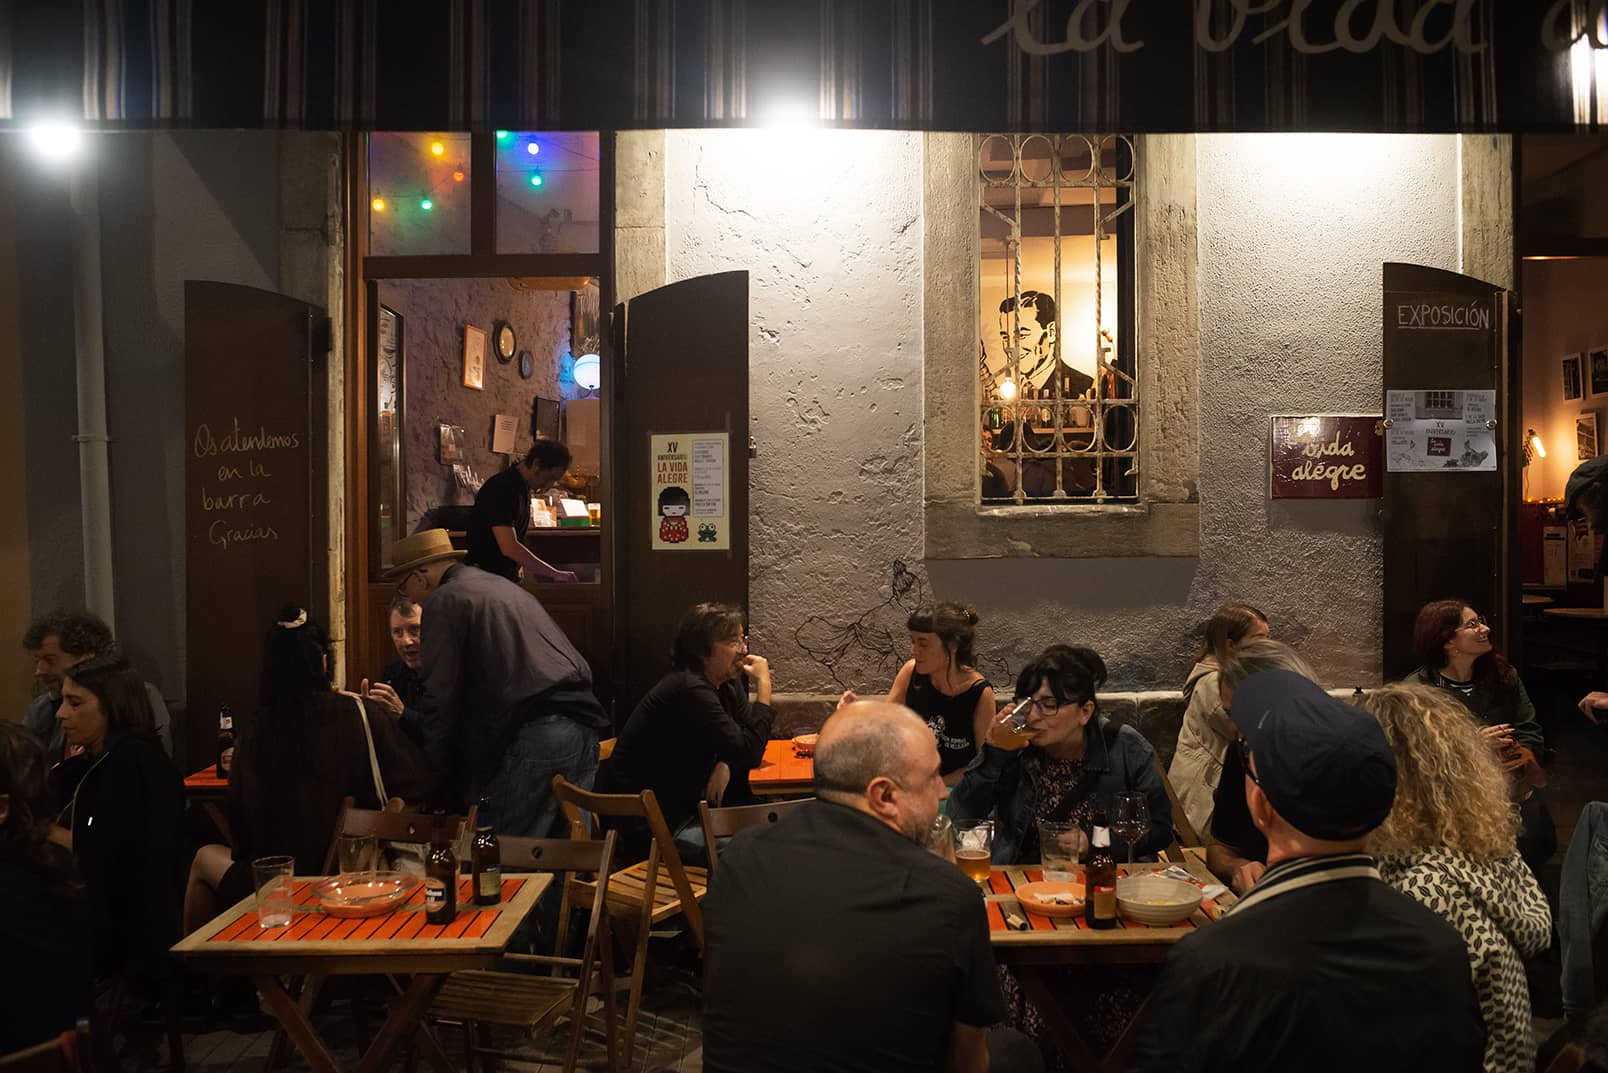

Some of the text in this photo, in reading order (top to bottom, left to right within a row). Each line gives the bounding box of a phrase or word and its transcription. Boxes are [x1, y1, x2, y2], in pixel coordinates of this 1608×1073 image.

[1397, 300, 1490, 329] EXPOSICIÓN
[194, 416, 300, 457] Os atendemos
[667, 441, 678, 453] XV
[218, 458, 272, 480] en la
[657, 462, 688, 472] LA VIDA
[657, 473, 688, 484] ALEGRE
[202, 488, 271, 510] barra
[208, 520, 278, 550] Gracias
